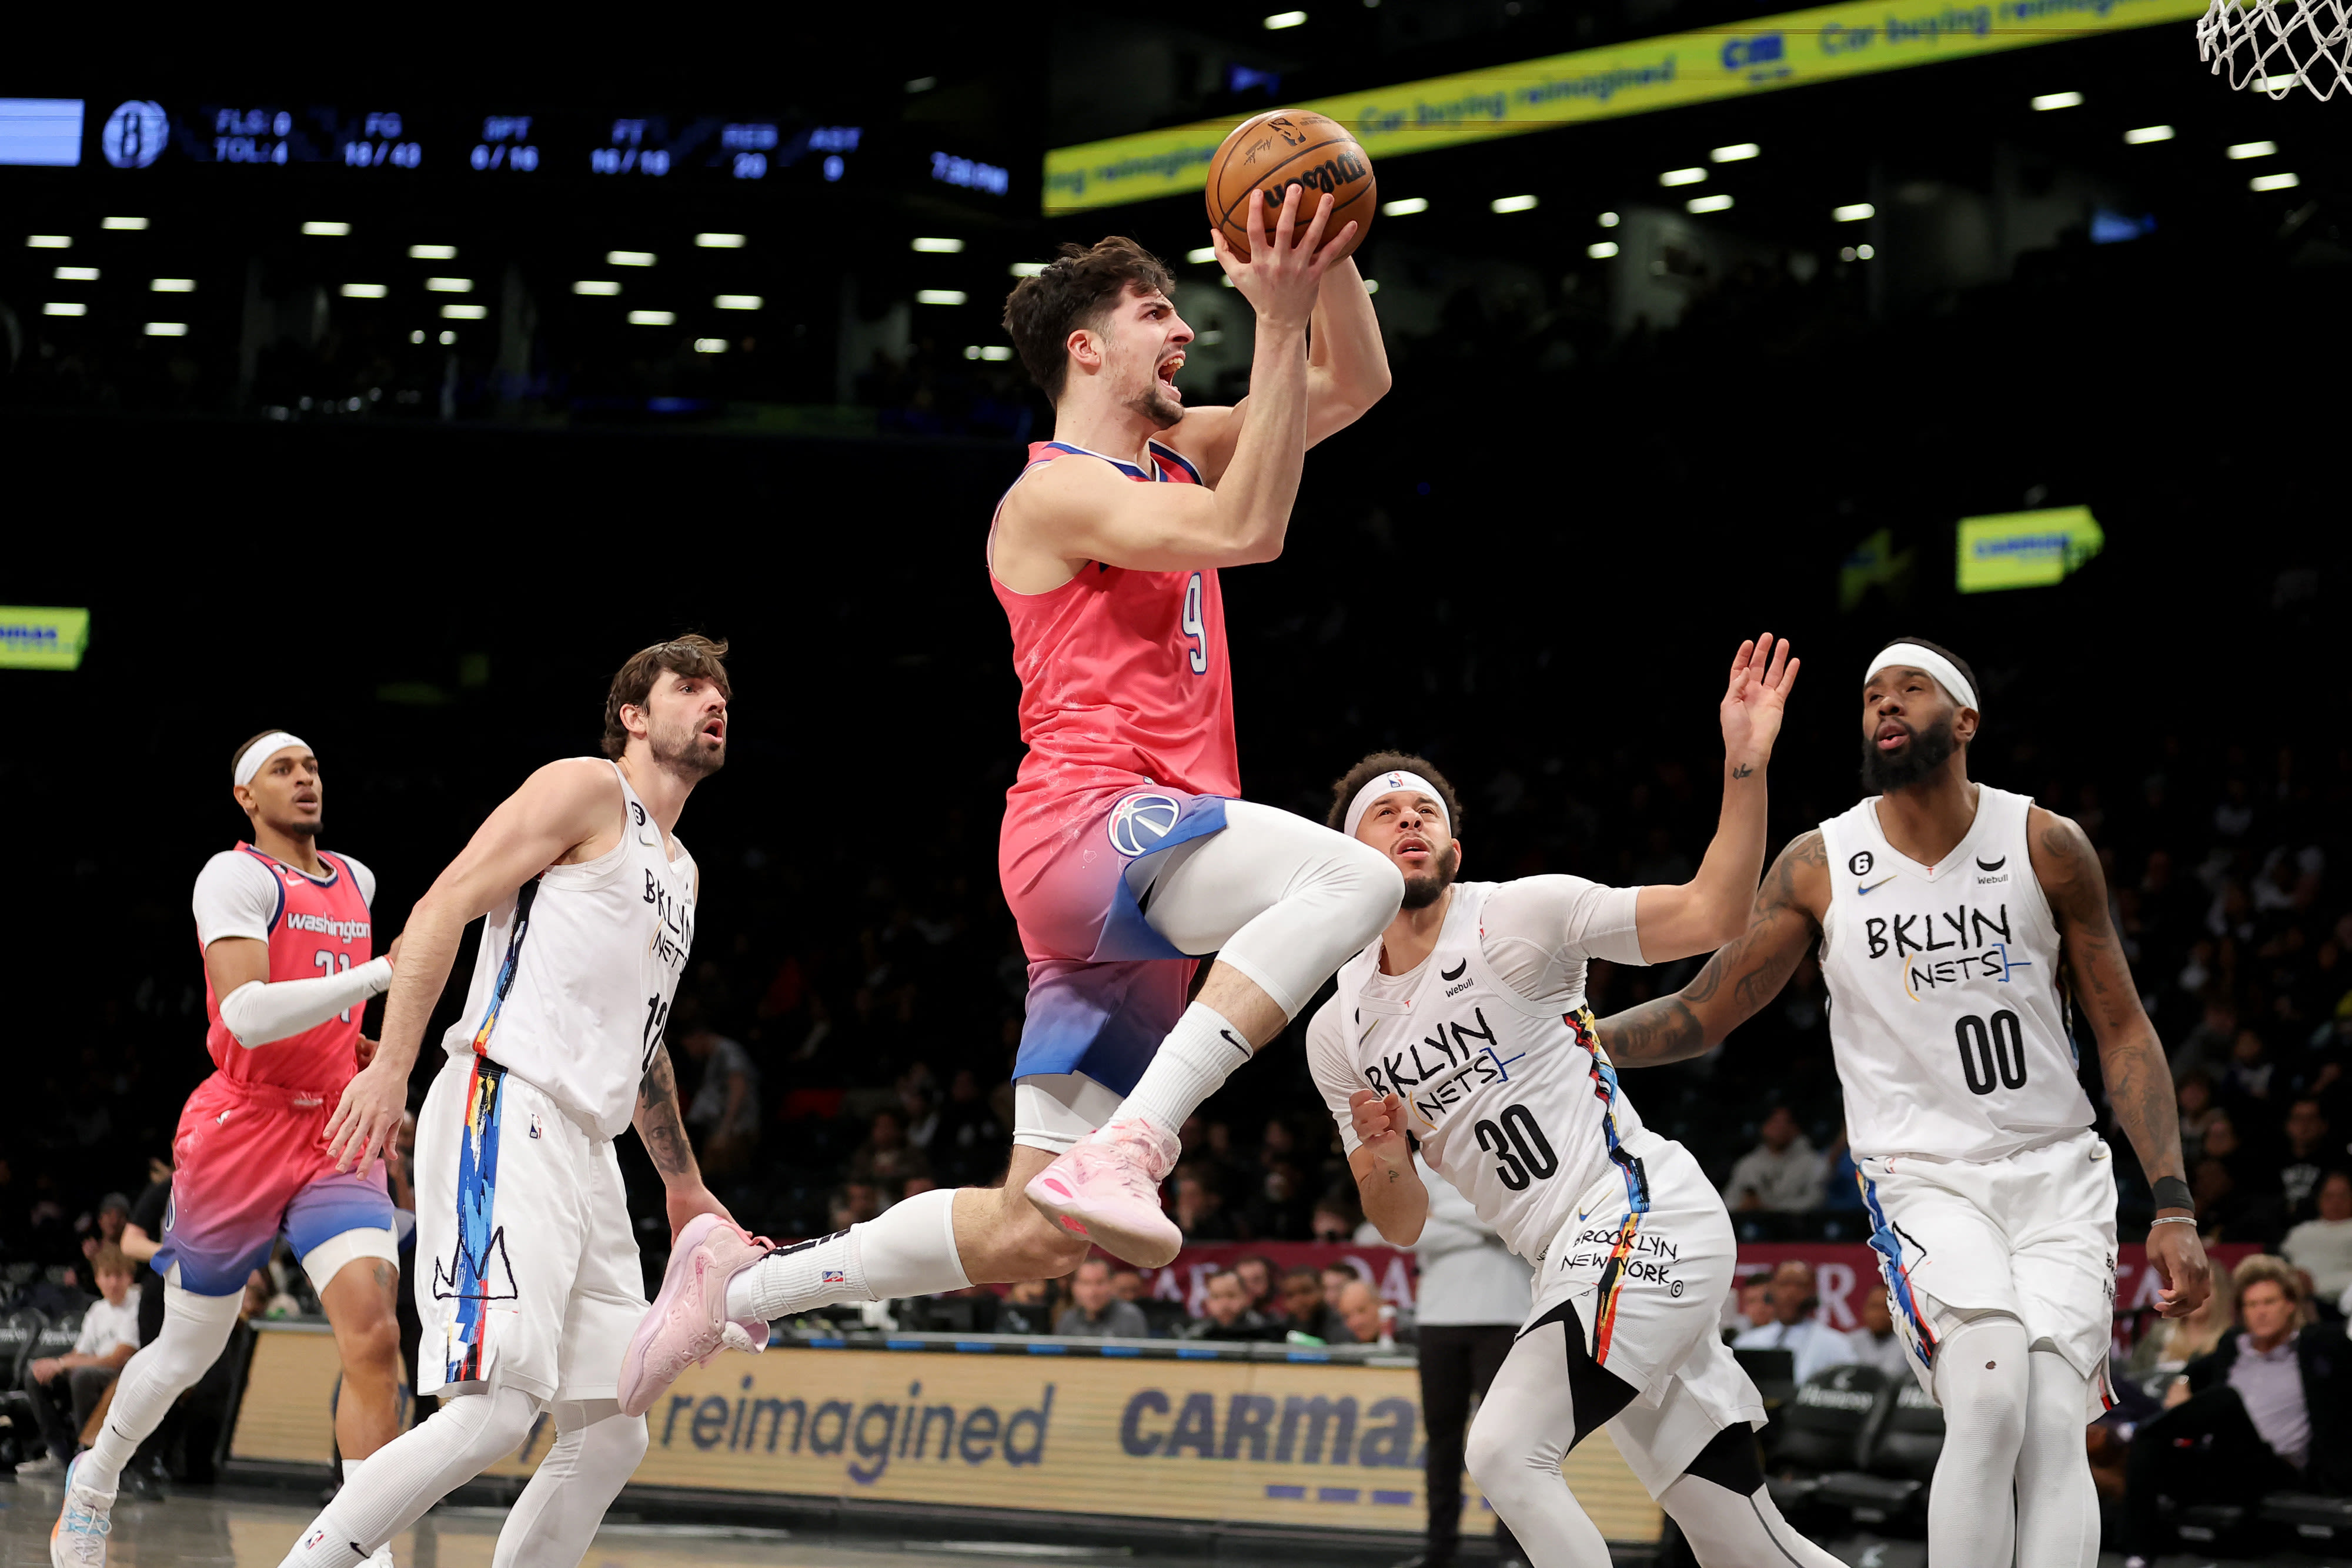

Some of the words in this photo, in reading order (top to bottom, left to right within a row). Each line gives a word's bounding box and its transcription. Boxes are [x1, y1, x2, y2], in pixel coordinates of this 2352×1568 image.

[1181, 571, 1208, 675] 9
[643, 868, 693, 950] BKLYN
[1976, 874, 2009, 885] Webull
[287, 911, 370, 944] washington
[1865, 904, 2012, 959] BKLYN
[1445, 977, 1475, 998] Webull
[1911, 950, 2003, 992] NETS
[1364, 1007, 1498, 1099] BKLYN
[1955, 1009, 2027, 1095] 00
[1416, 1056, 1499, 1121] NETS
[1474, 1104, 1559, 1191] 30
[1560, 1252, 1609, 1272] NEW
[1617, 1257, 1671, 1286] YORK
[661, 1375, 1055, 1485] reimagined
[1120, 1389, 1426, 1469] CARma
